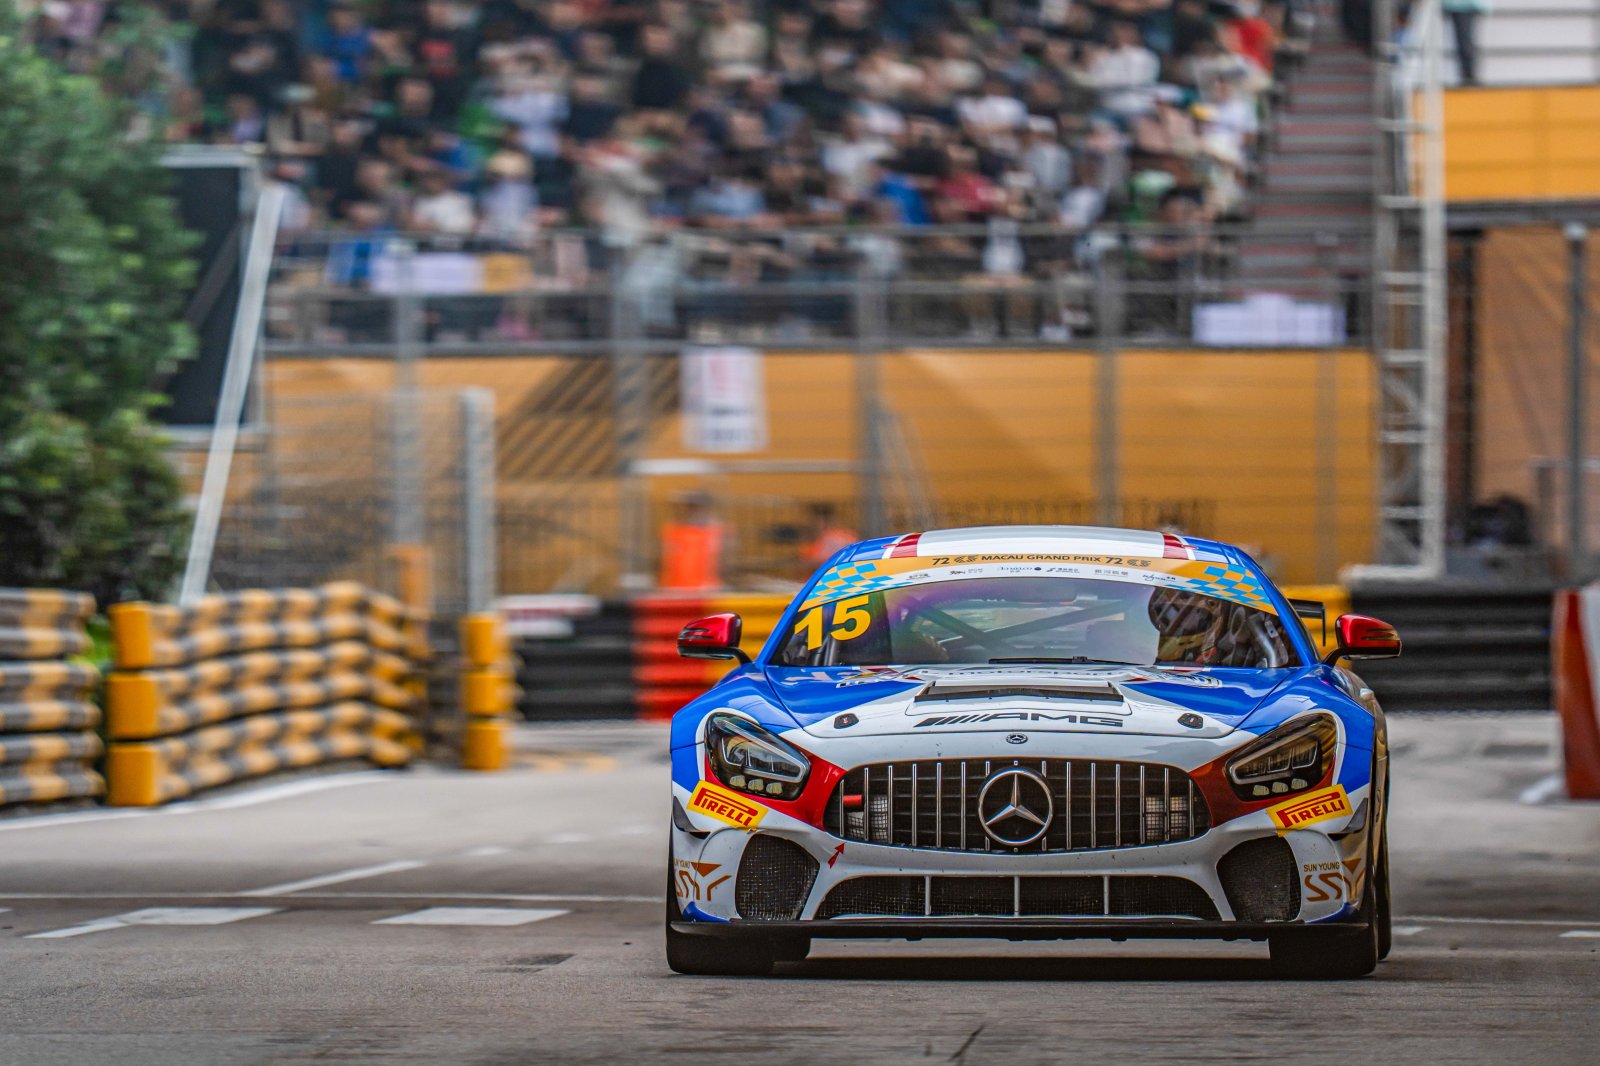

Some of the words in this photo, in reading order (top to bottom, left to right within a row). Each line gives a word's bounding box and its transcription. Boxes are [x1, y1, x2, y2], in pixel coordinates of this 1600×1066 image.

[932, 557, 950, 566] 72
[1105, 556, 1123, 565] 72
[794, 594, 871, 651] 15
[979, 712, 1124, 728] AMG
[693, 787, 759, 827] PIRELLI
[1276, 791, 1345, 828] PIRELLI
[1303, 863, 1318, 872] SUN
[1319, 861, 1340, 871] YOUNG
